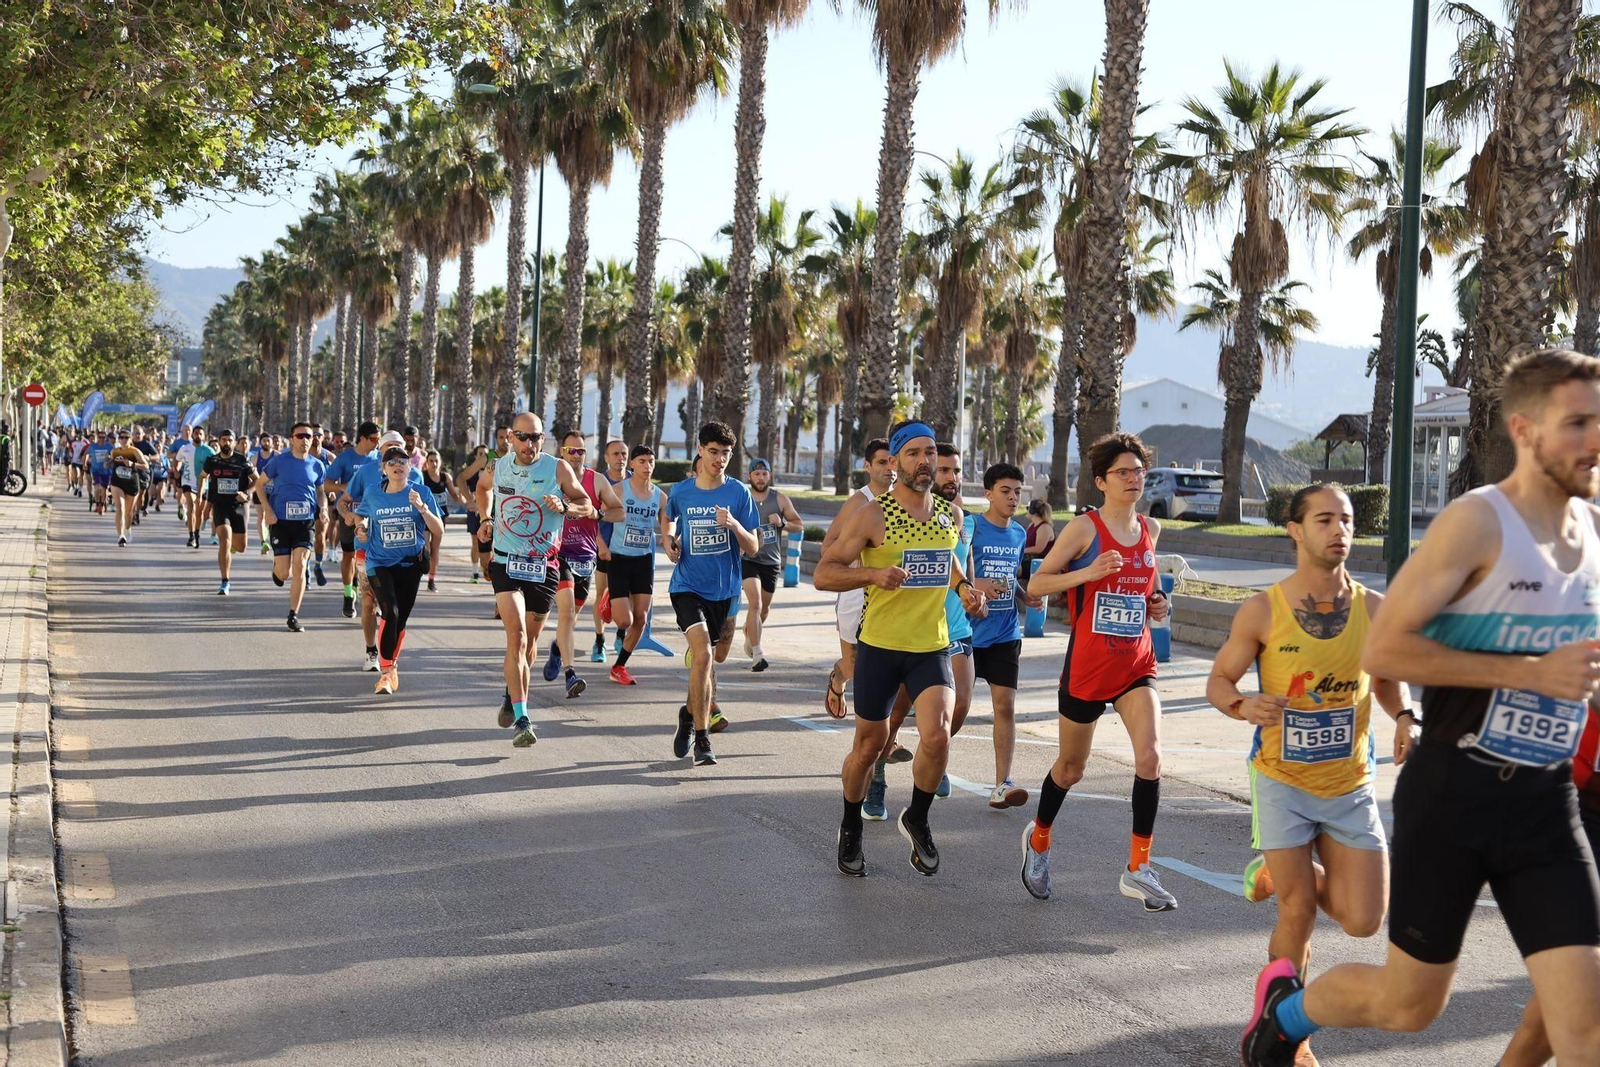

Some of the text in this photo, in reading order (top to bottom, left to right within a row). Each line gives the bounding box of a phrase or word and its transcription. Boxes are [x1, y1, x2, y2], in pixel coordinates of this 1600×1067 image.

[376, 504, 413, 515] mayoral
[626, 506, 656, 518] nerja
[687, 505, 730, 516] mayol
[386, 531, 413, 540] 1773
[694, 534, 725, 545] 2210
[511, 562, 542, 573] 1669
[908, 563, 946, 575] 2053
[1117, 576, 1148, 584] ATLETISMO
[1508, 580, 1542, 592] vive
[1101, 608, 1141, 622] 2112
[1502, 710, 1569, 744] 1992
[1292, 728, 1346, 746] 1598
